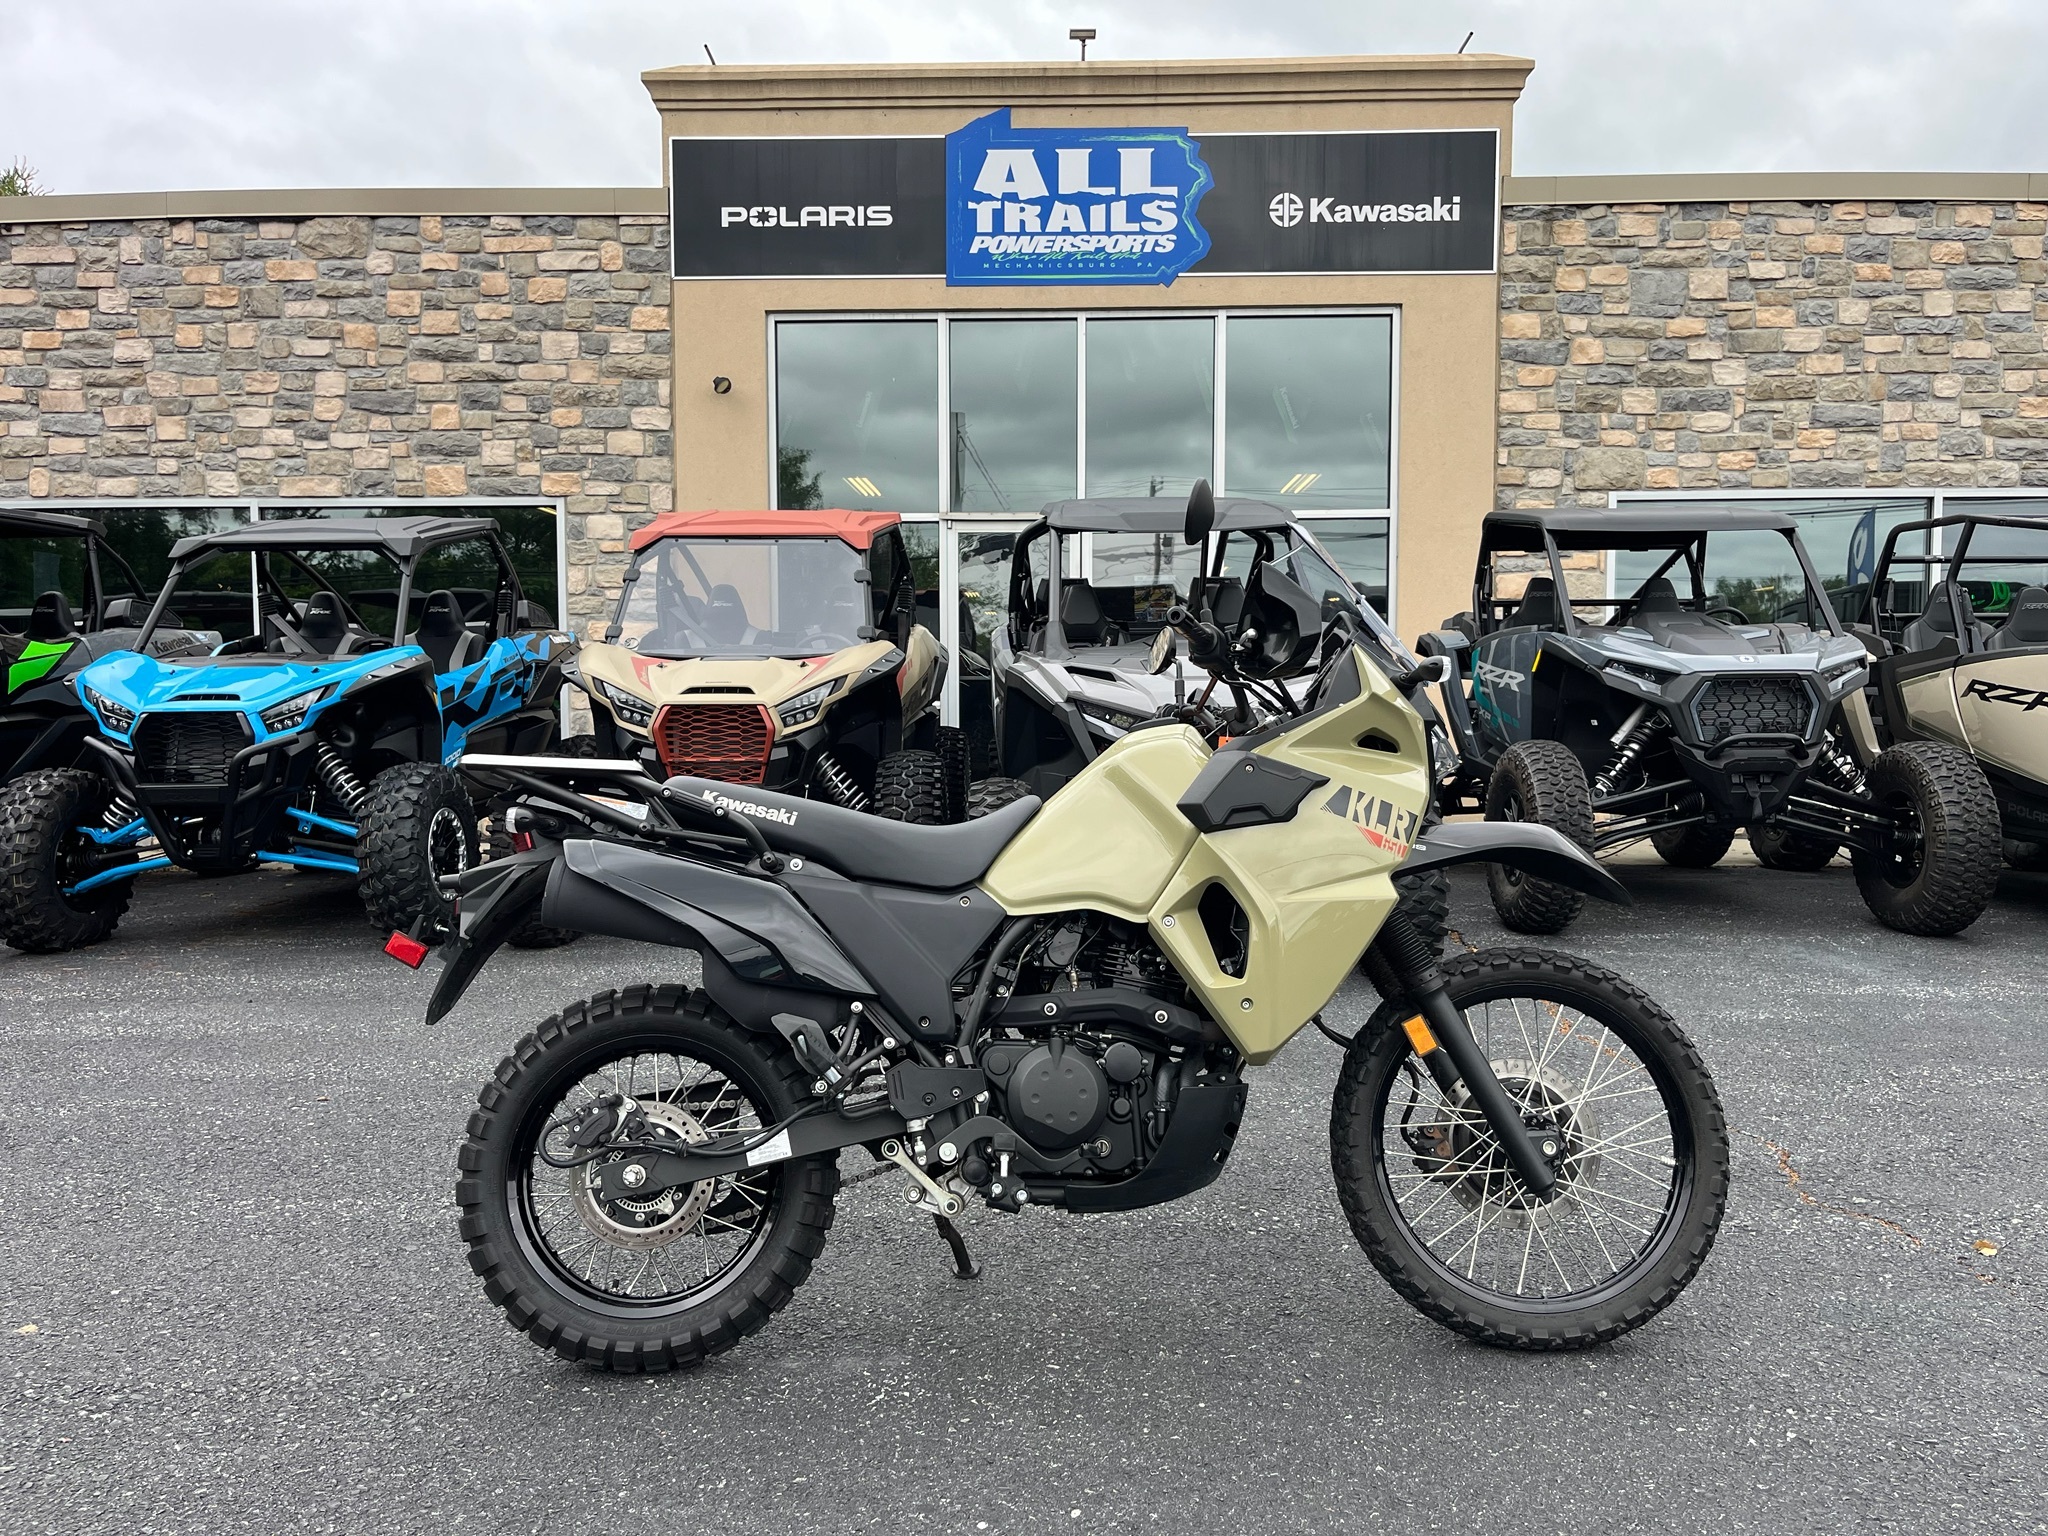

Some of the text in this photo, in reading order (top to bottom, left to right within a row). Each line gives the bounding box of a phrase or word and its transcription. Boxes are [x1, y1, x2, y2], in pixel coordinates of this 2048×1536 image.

[972, 148, 1178, 200] ALL
[721, 205, 893, 228] POLARIS
[968, 199, 1178, 233] TRAILS
[1309, 196, 1461, 223] Kawasaki
[969, 234, 1177, 254] POWERSPORTS
[1473, 660, 1526, 692] RZR
[701, 789, 798, 826] Kawasaki
[1346, 785, 1412, 845] KLR
